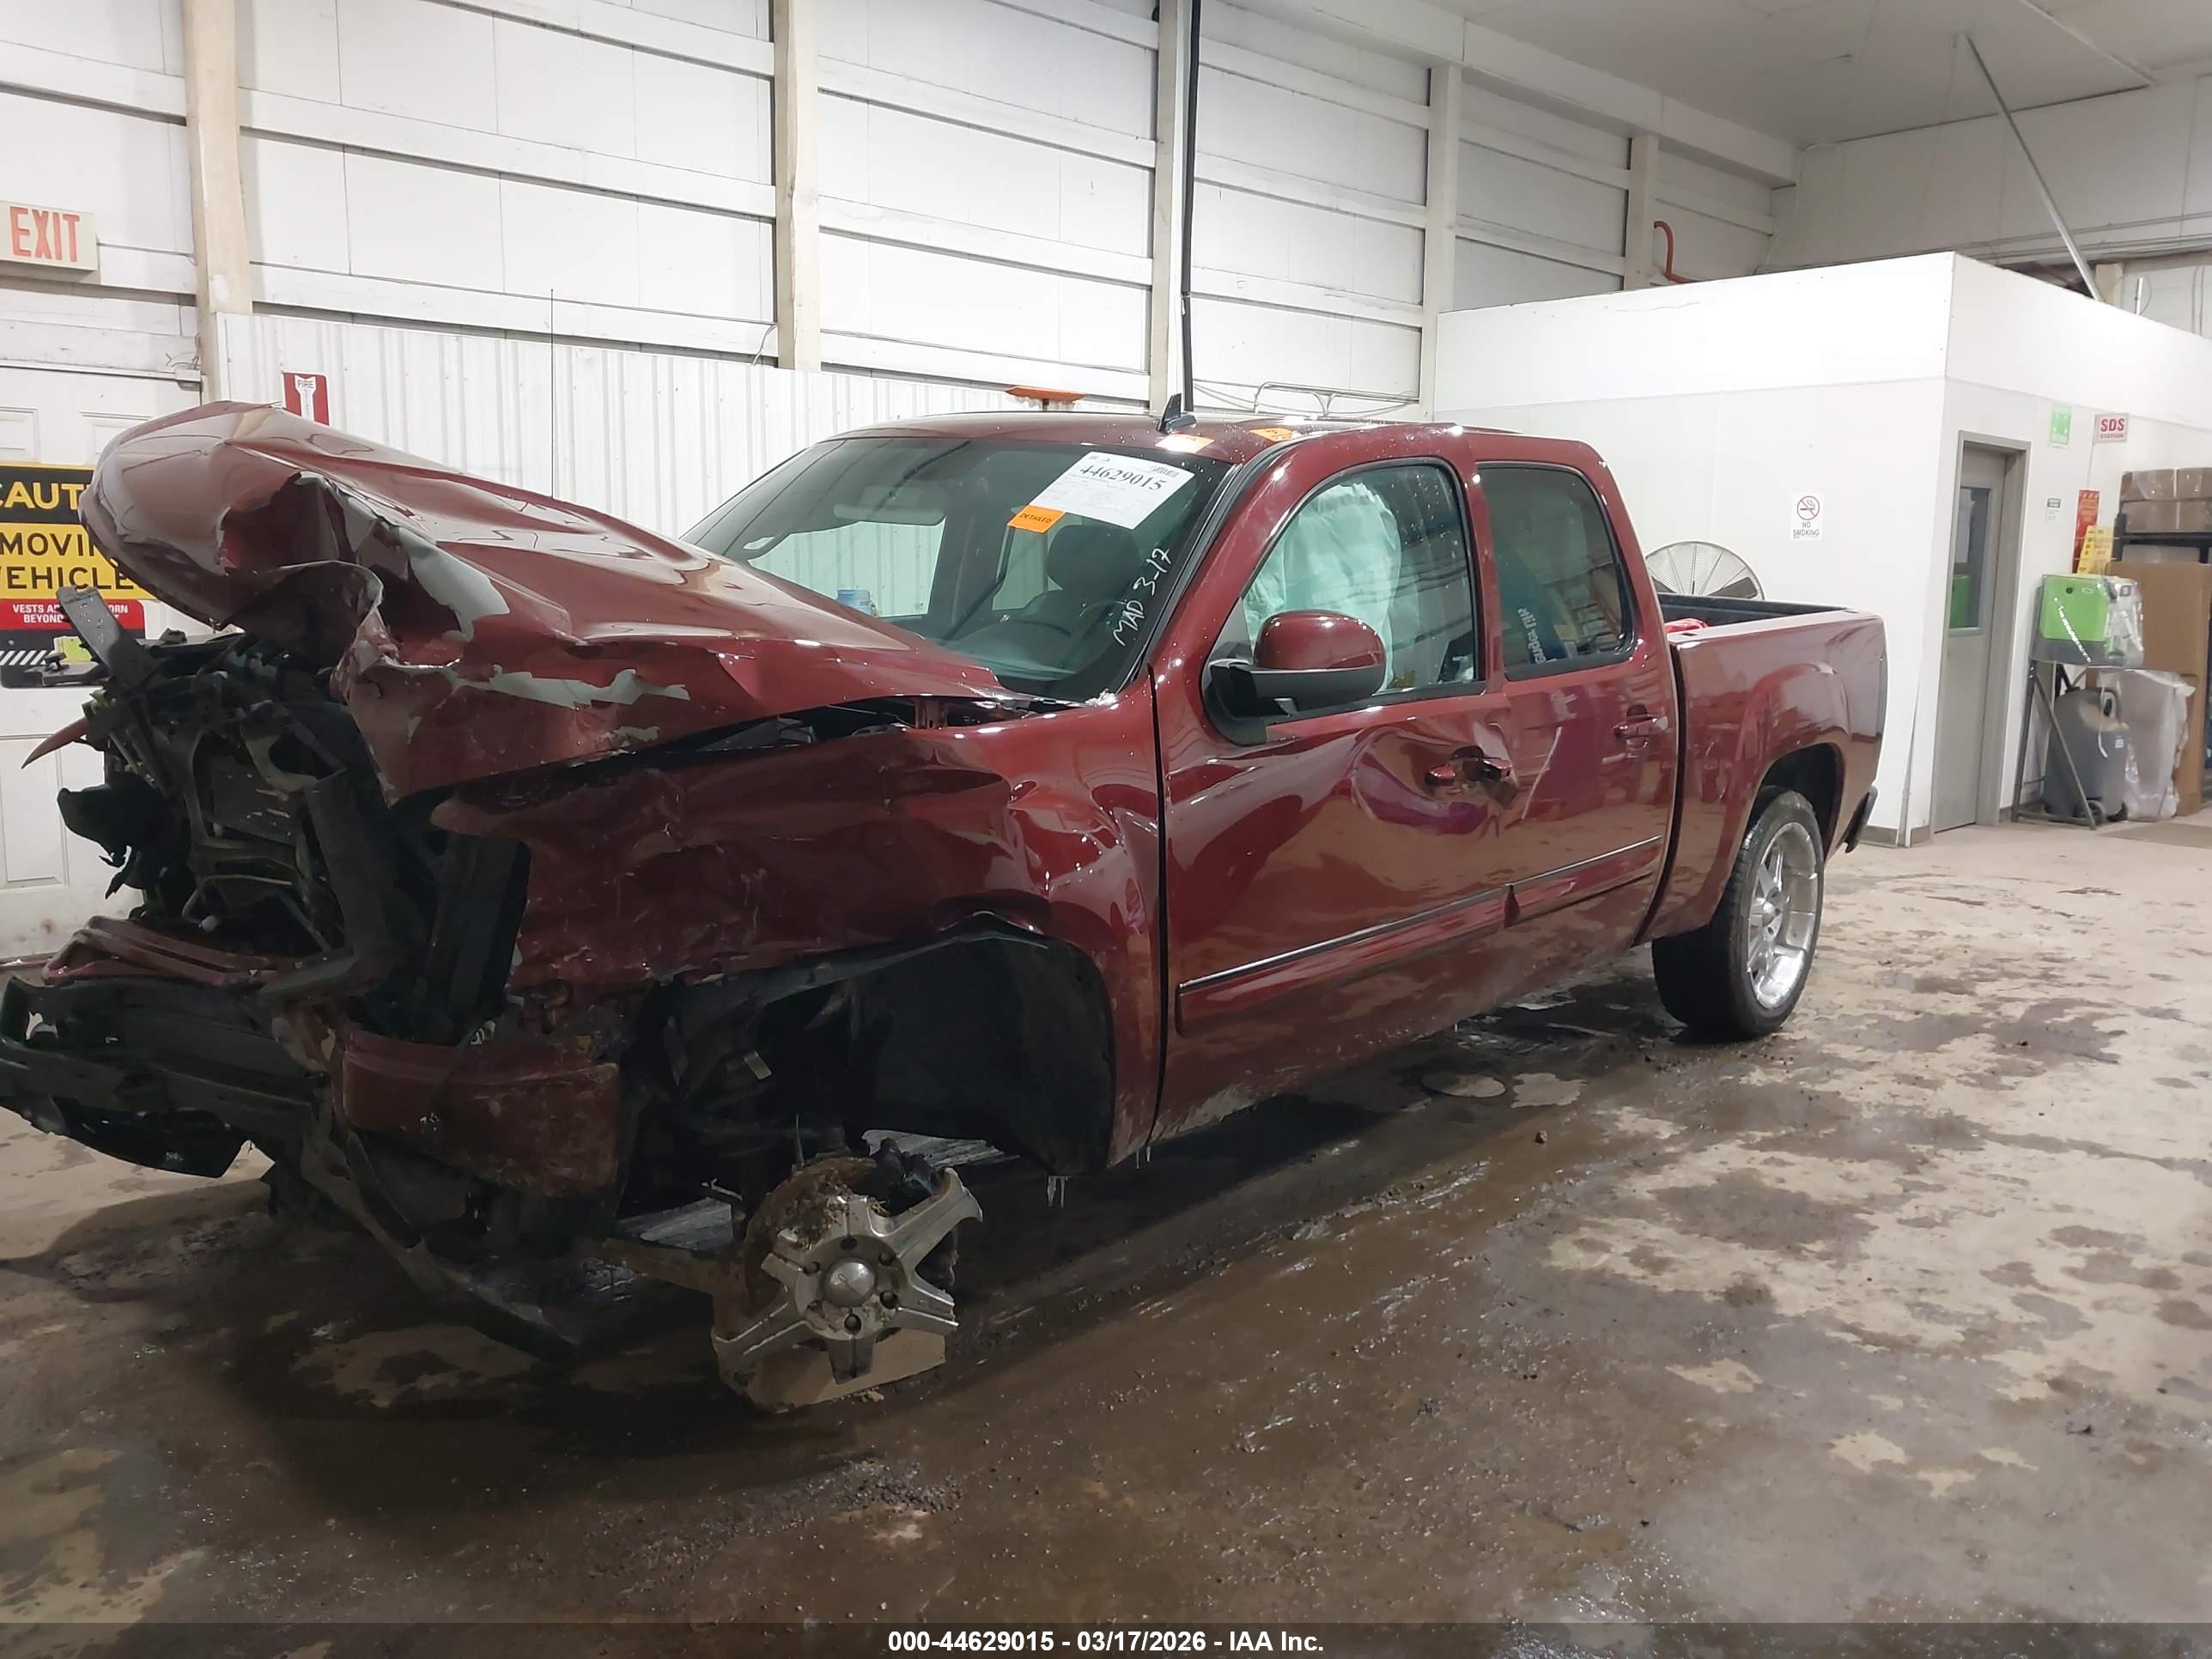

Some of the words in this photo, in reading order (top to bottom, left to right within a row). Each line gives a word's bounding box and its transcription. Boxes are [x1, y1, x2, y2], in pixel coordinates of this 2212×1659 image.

[9, 205, 81, 263] EXIT
[297, 380, 314, 389] FIRE
[2100, 417, 2125, 432] SDS
[1080, 464, 1168, 490] 44629015
[0, 481, 88, 510] AUT
[1020, 513, 1052, 524] DETAILED
[0, 566, 134, 590] EHICLE
[1133, 548, 1171, 596] 3-17
[12, 604, 45, 613] VESTS
[23, 614, 64, 623] BEYOND
